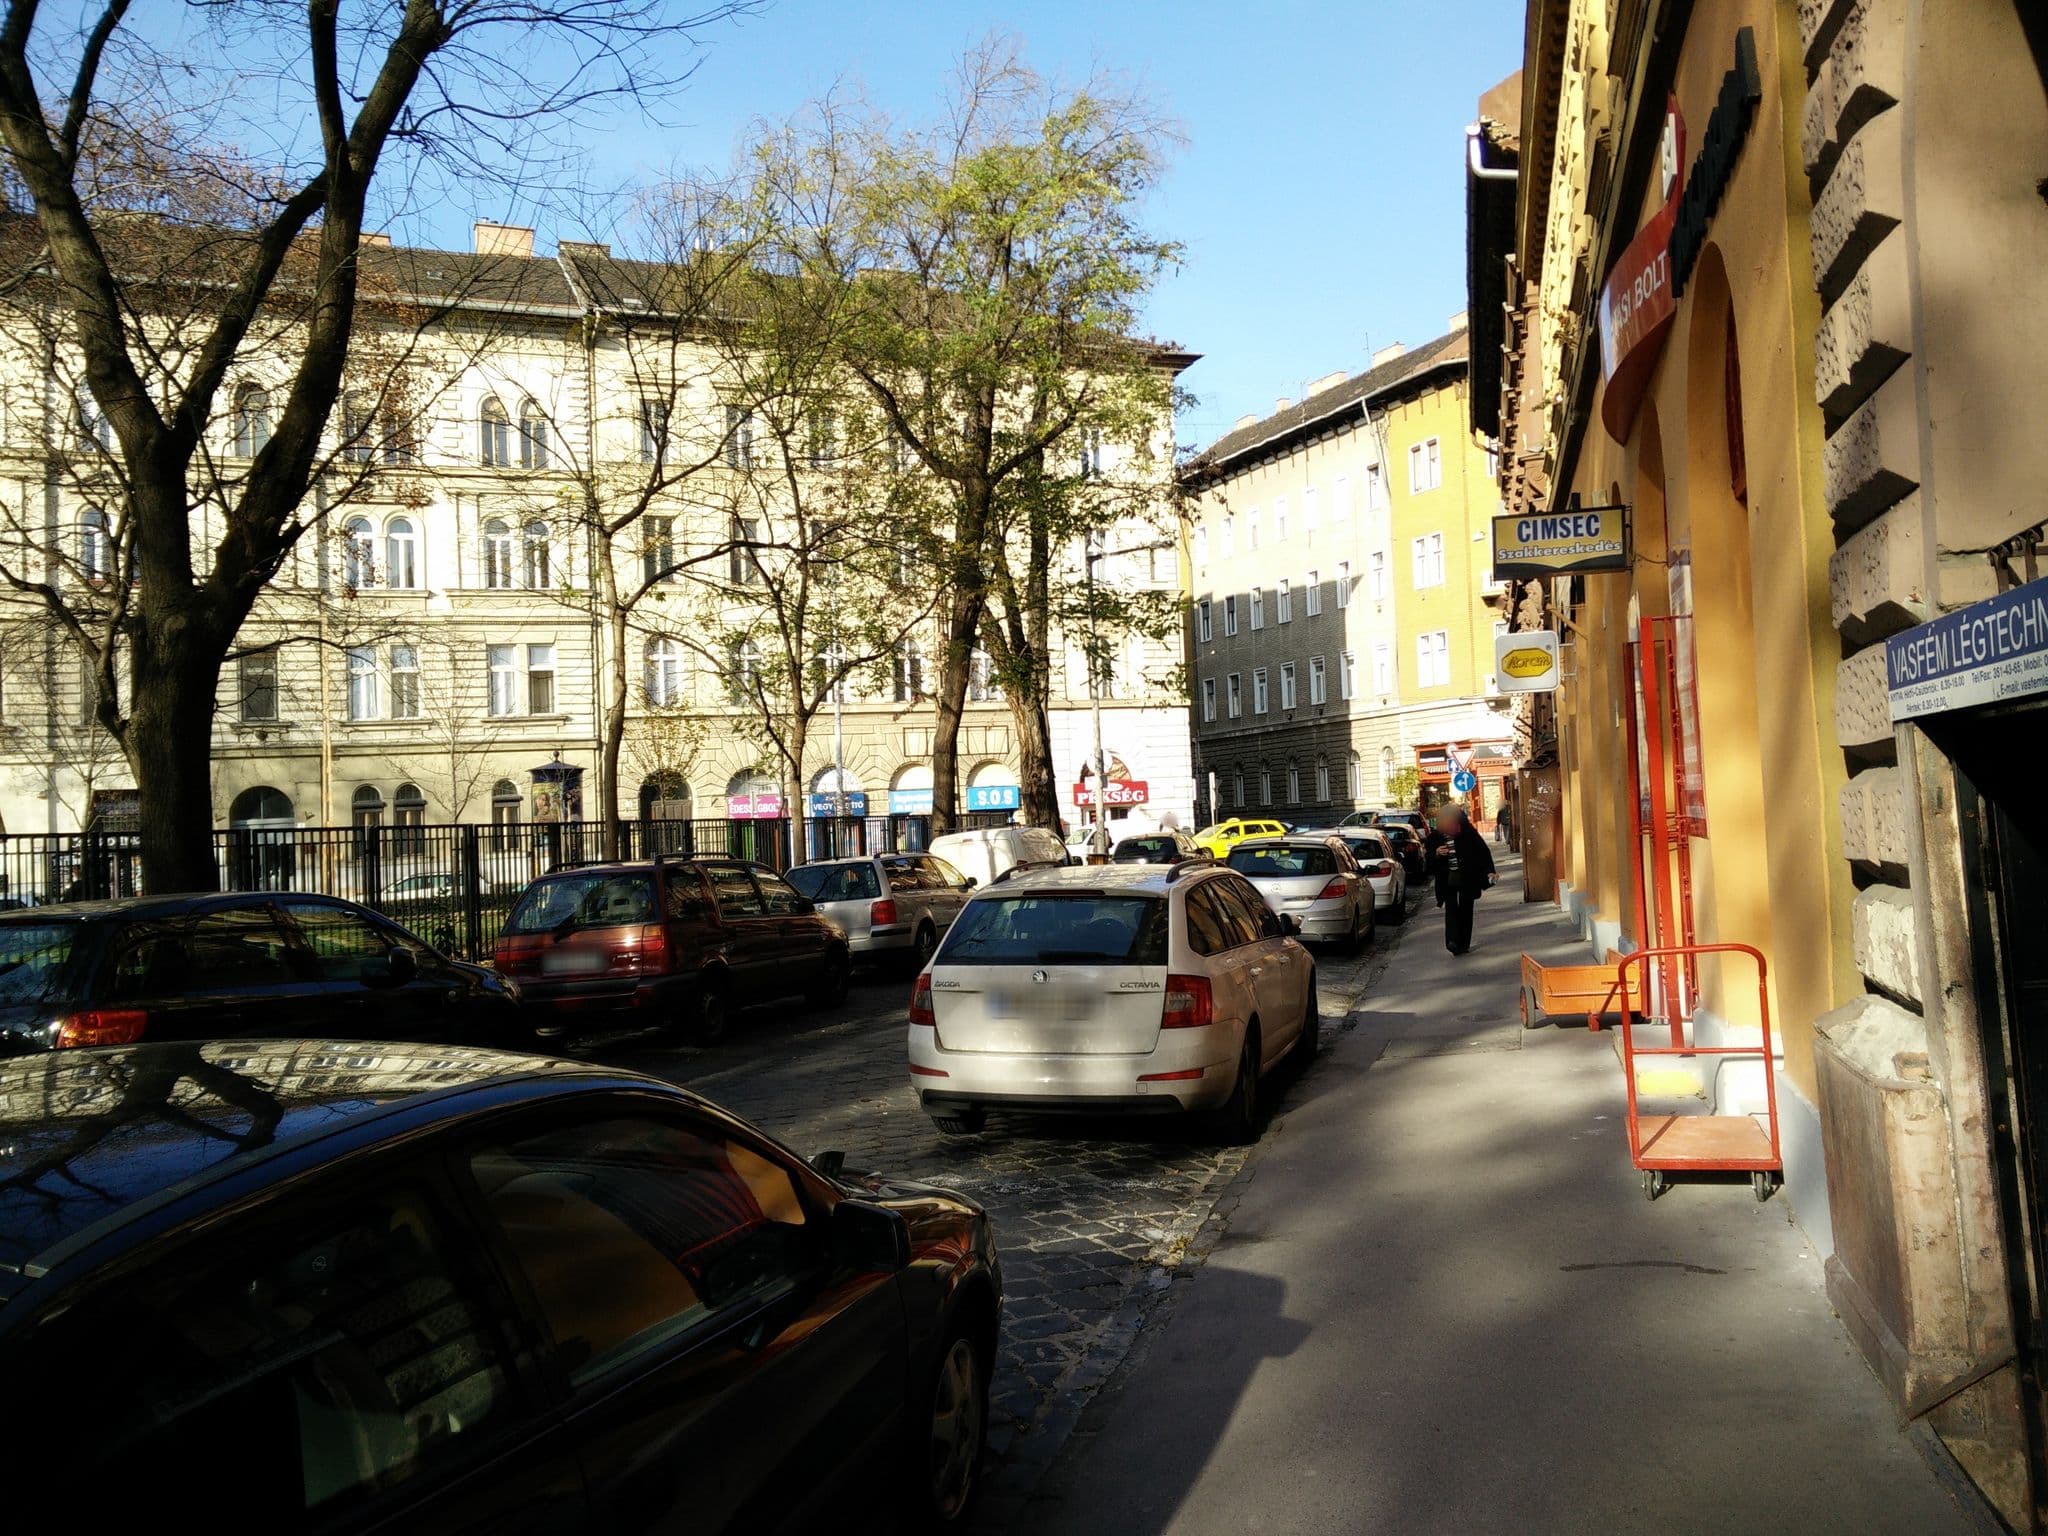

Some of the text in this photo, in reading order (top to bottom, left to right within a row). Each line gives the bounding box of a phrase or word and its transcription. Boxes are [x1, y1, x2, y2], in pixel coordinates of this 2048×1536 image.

[1634, 249, 1668, 310] BOLT
[1517, 514, 1600, 543] CIMSEC
[1498, 540, 1621, 560] Szakkereskedés
[1892, 627, 1949, 684] VASFÉM
[1119, 981, 1161, 989] OCTAVIA
